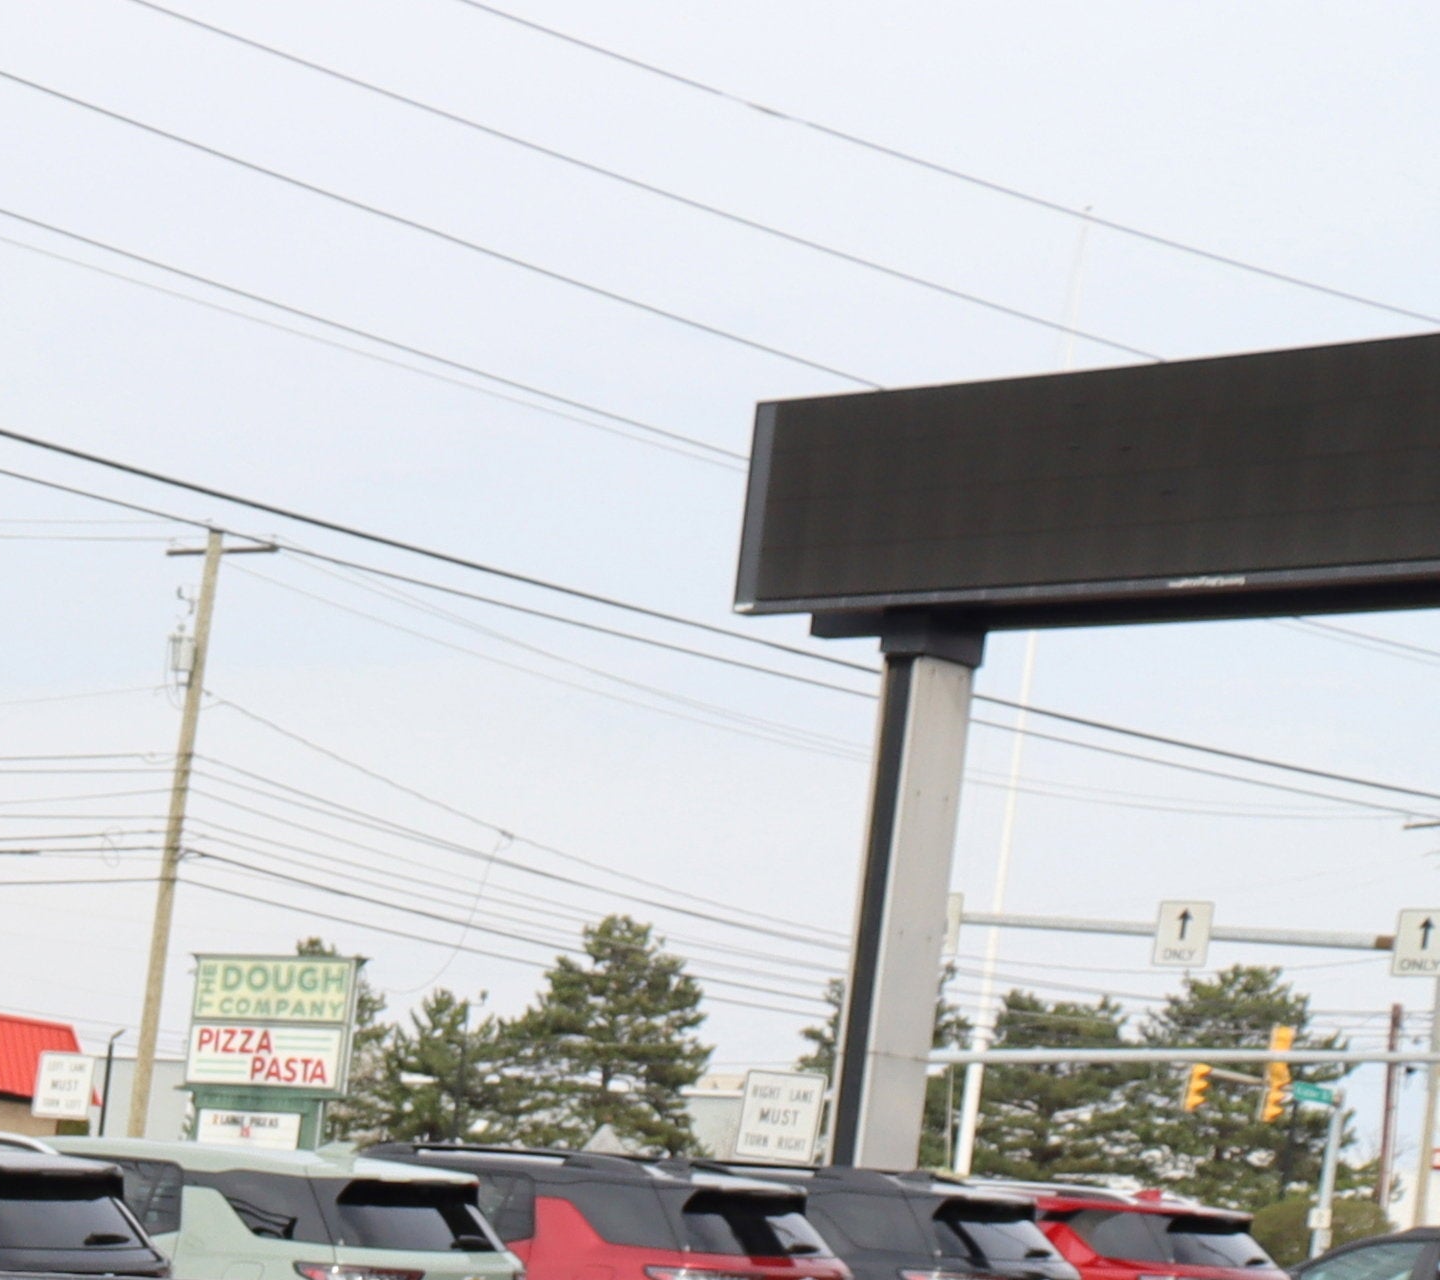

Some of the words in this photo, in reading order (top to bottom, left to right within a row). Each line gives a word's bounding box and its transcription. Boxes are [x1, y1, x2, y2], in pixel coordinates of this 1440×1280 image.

[1163, 948, 1196, 962] ONLY
[198, 964, 217, 1013] THE
[221, 964, 345, 993] DOUGH
[219, 998, 345, 1018] COMPANY
[198, 1028, 273, 1054] PIZZA
[250, 1056, 327, 1084] PASTA
[50, 1079, 79, 1092] MUST
[759, 1107, 800, 1127] MUST
